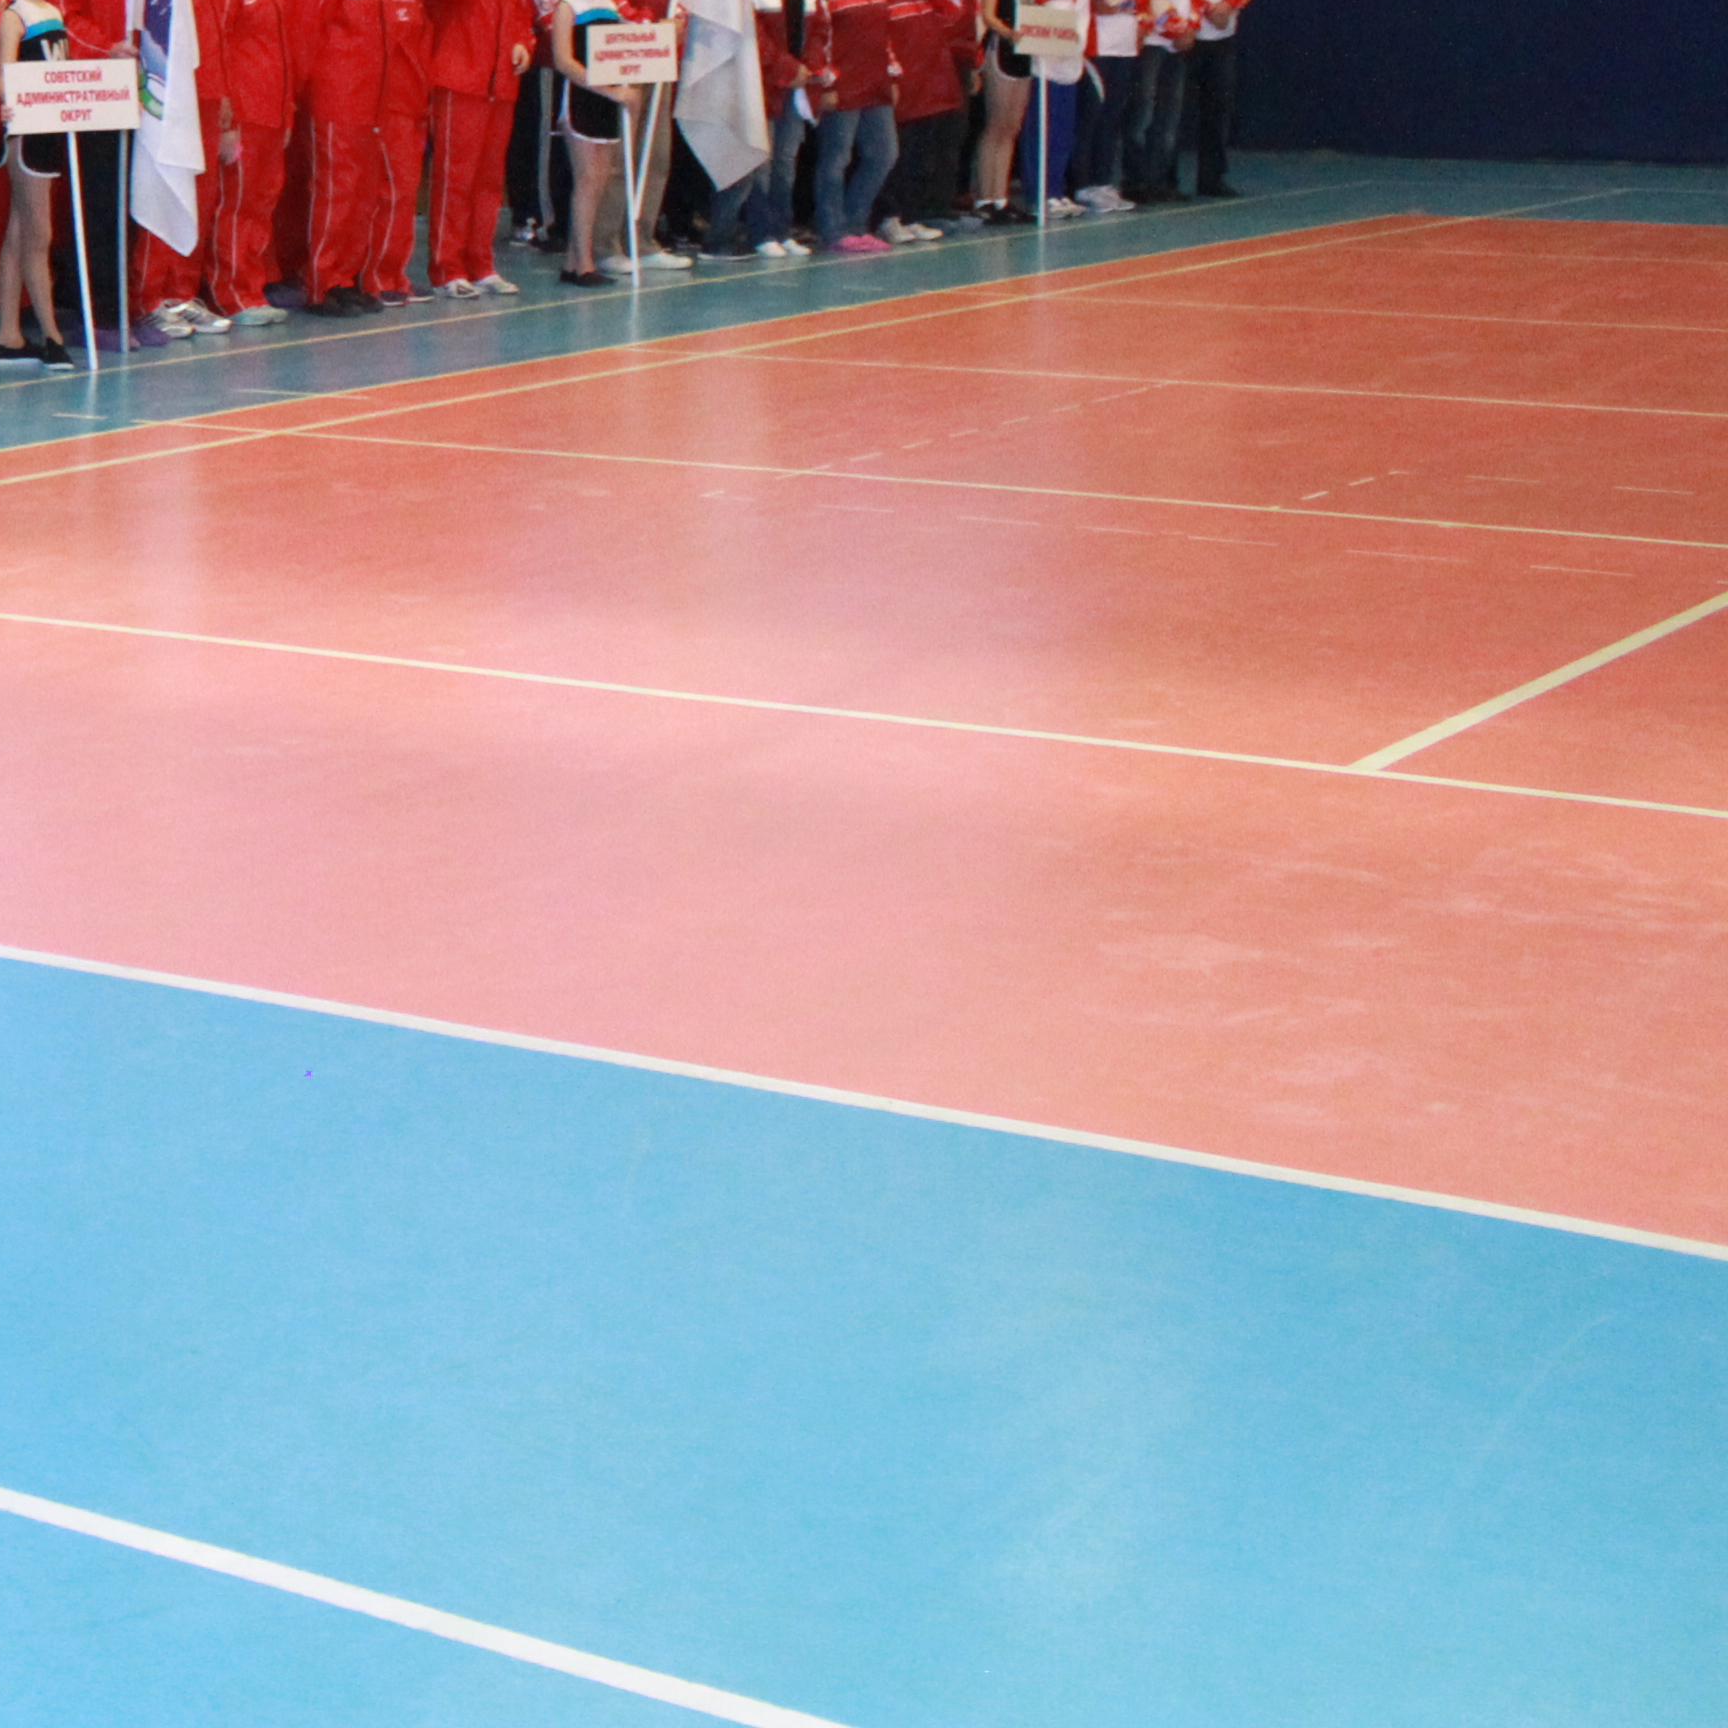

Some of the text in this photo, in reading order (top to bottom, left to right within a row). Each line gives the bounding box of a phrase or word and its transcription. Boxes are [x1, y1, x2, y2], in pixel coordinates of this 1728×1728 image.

[44, 67, 102, 84] СОВЕТСКИЙ
[16, 85, 130, 107] АДМИНИСТРАТИВНЫЙ
[60, 109, 93, 122] ОКРУГ
